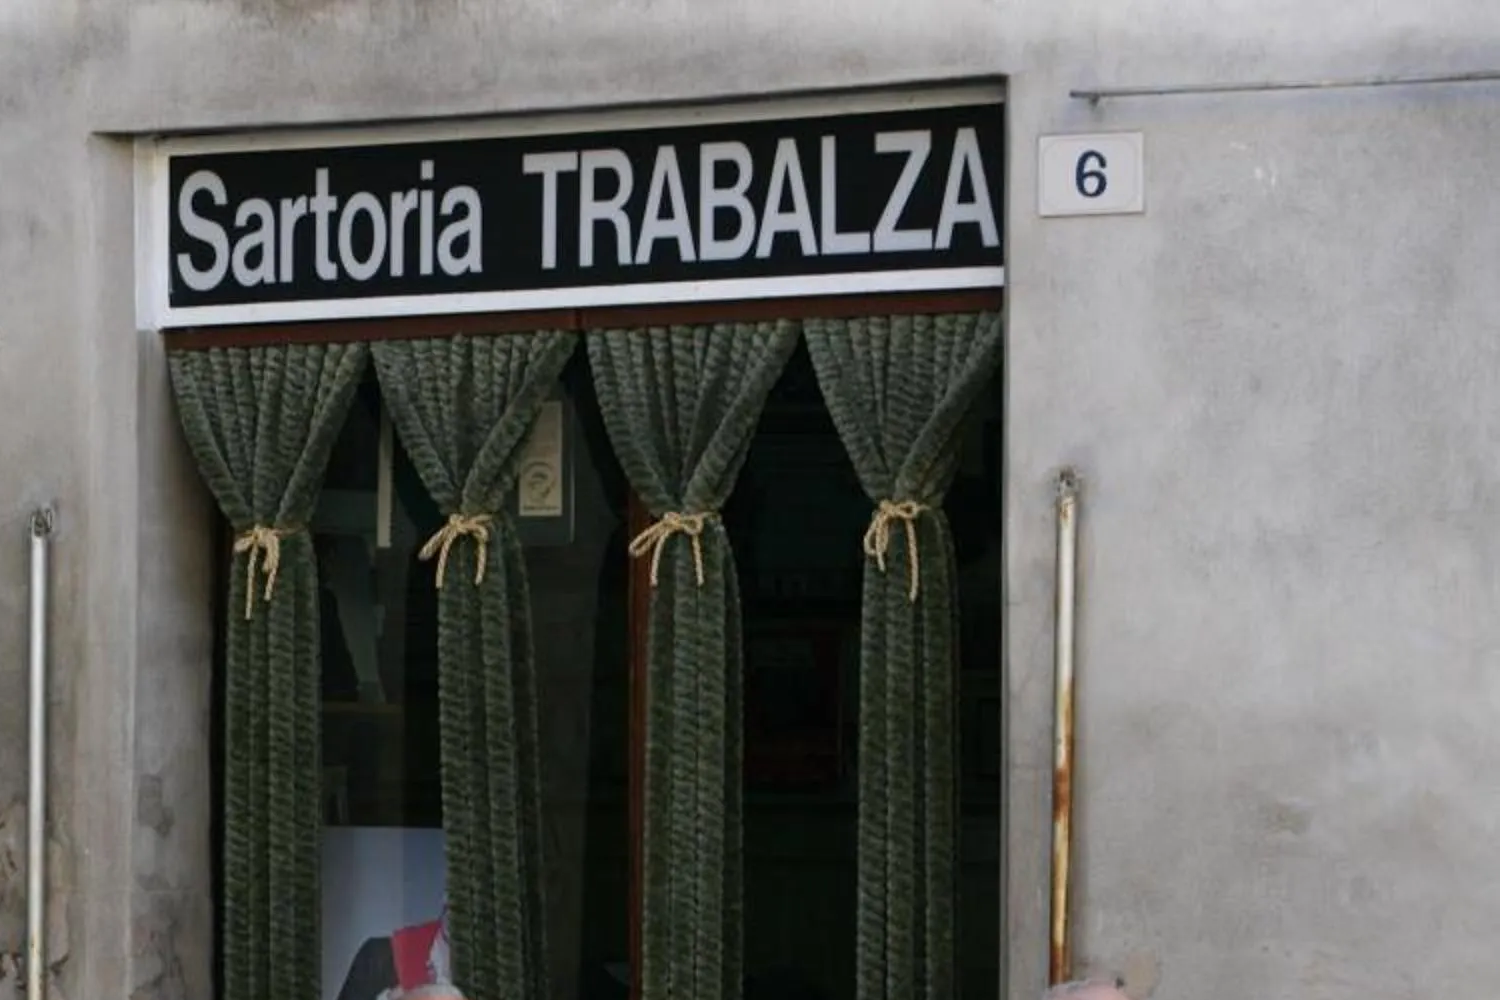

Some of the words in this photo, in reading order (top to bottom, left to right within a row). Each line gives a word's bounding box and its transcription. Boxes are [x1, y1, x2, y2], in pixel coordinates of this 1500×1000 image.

[177, 160, 483, 291] Sartoria
[522, 127, 999, 269] TRABALZA
[1075, 150, 1107, 198] 6
